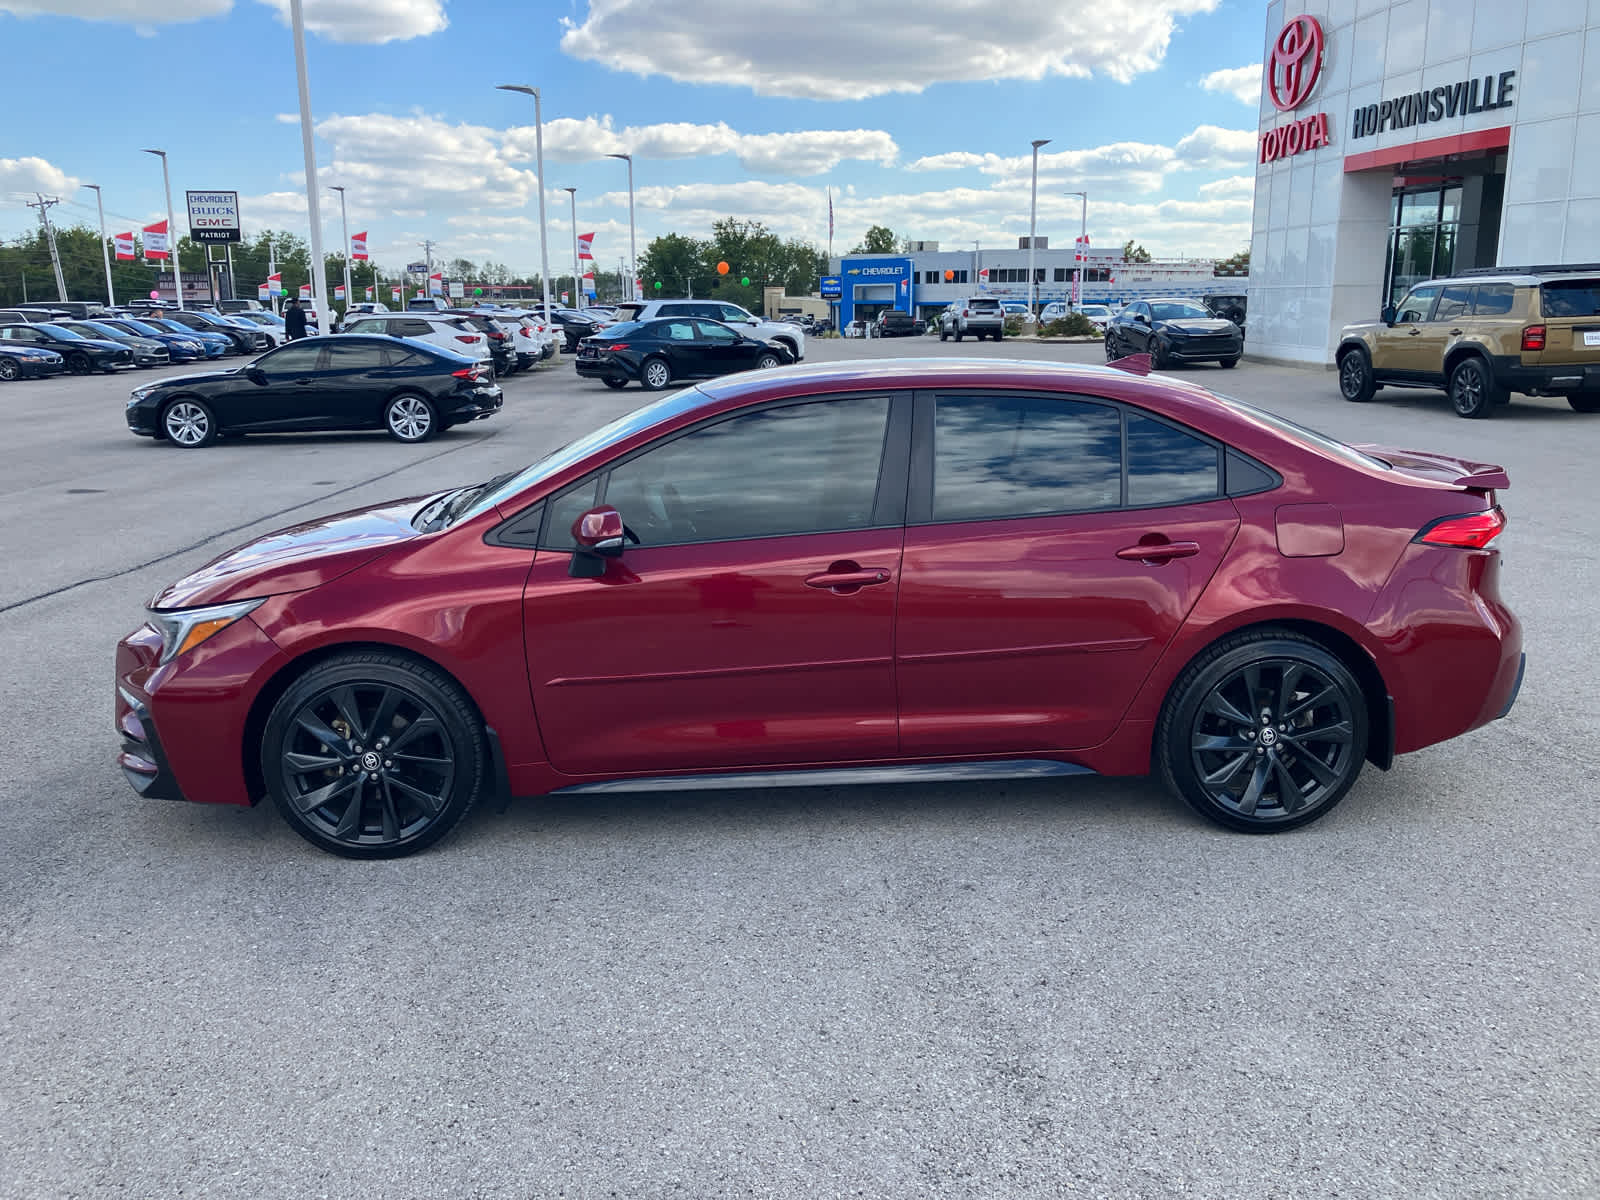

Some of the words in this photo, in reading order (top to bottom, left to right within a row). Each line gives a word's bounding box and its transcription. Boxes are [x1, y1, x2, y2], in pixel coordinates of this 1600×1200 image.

[1352, 70, 1516, 139] HOPKINSVILLE
[1259, 112, 1330, 164] TOYOTA
[189, 195, 233, 203] CHEVROLET
[191, 207, 235, 215] BUICK
[196, 218, 233, 227] GMC
[862, 266, 904, 276] CHEVROLET
